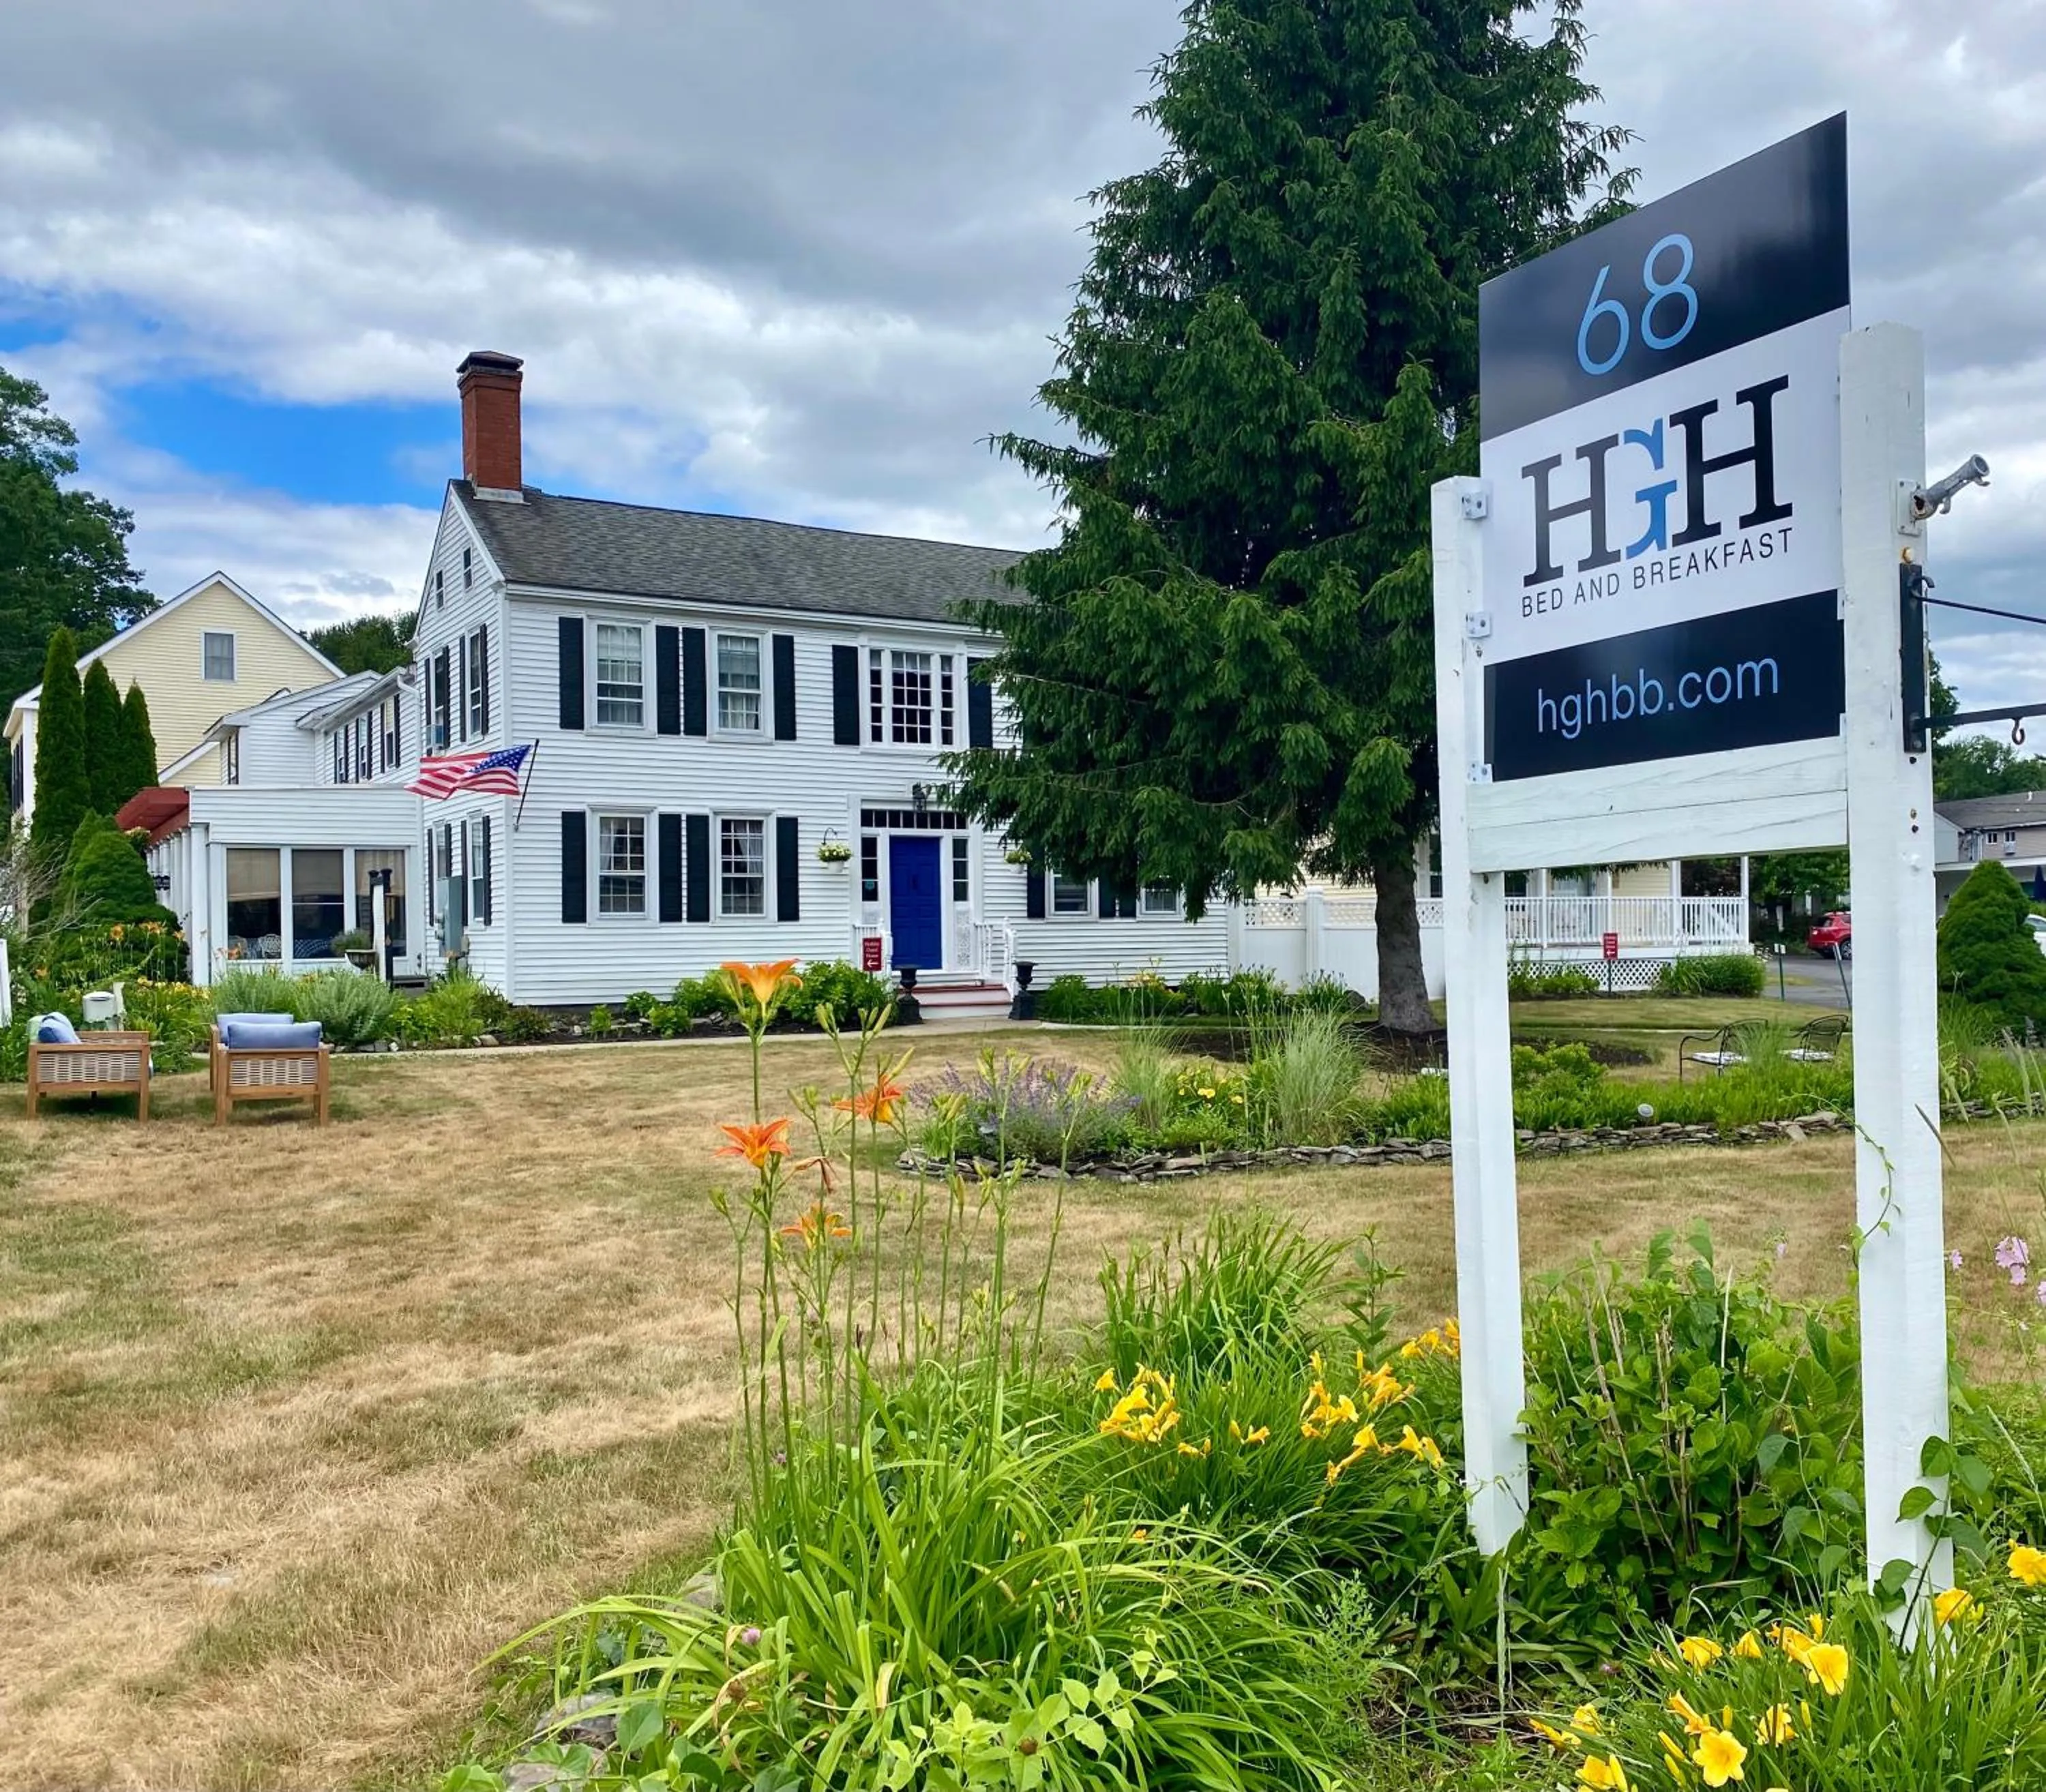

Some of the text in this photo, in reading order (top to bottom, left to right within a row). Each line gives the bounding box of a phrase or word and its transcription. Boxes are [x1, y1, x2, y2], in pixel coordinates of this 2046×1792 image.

[1577, 234, 1698, 375] 68
[1522, 375, 1793, 588] HGH
[1522, 527, 1794, 618] BED AND BREAKFAST
[1538, 657, 1778, 739] hghbb.com
